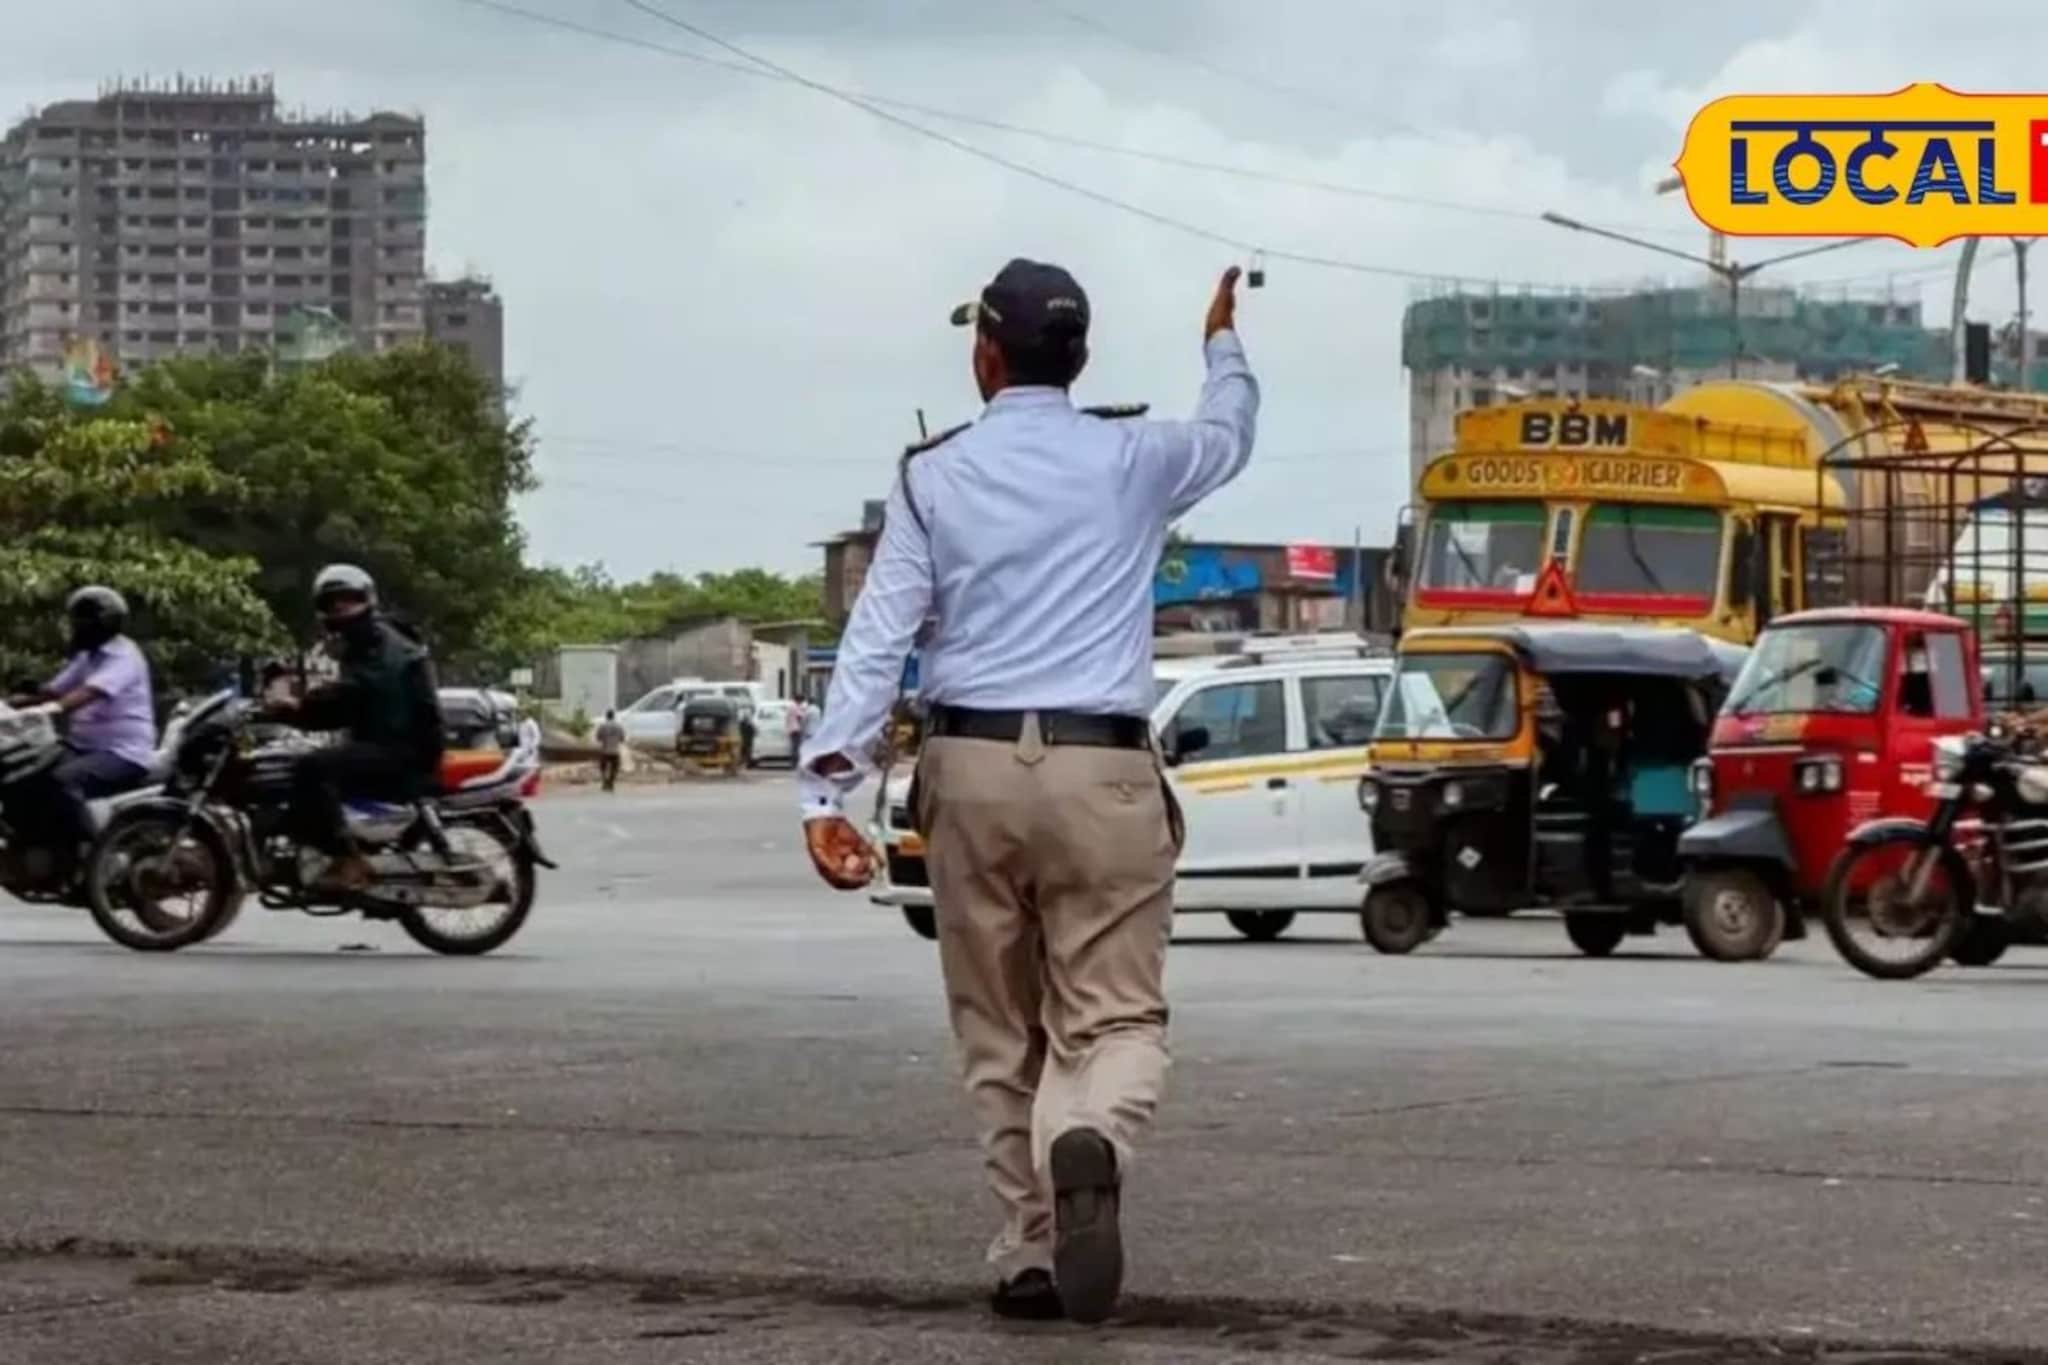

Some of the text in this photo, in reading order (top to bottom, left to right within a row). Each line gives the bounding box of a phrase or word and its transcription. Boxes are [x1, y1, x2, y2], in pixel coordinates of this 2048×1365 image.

[1521, 411, 1628, 447] BBM
[1467, 459, 1681, 489] GOODS CARRIER
